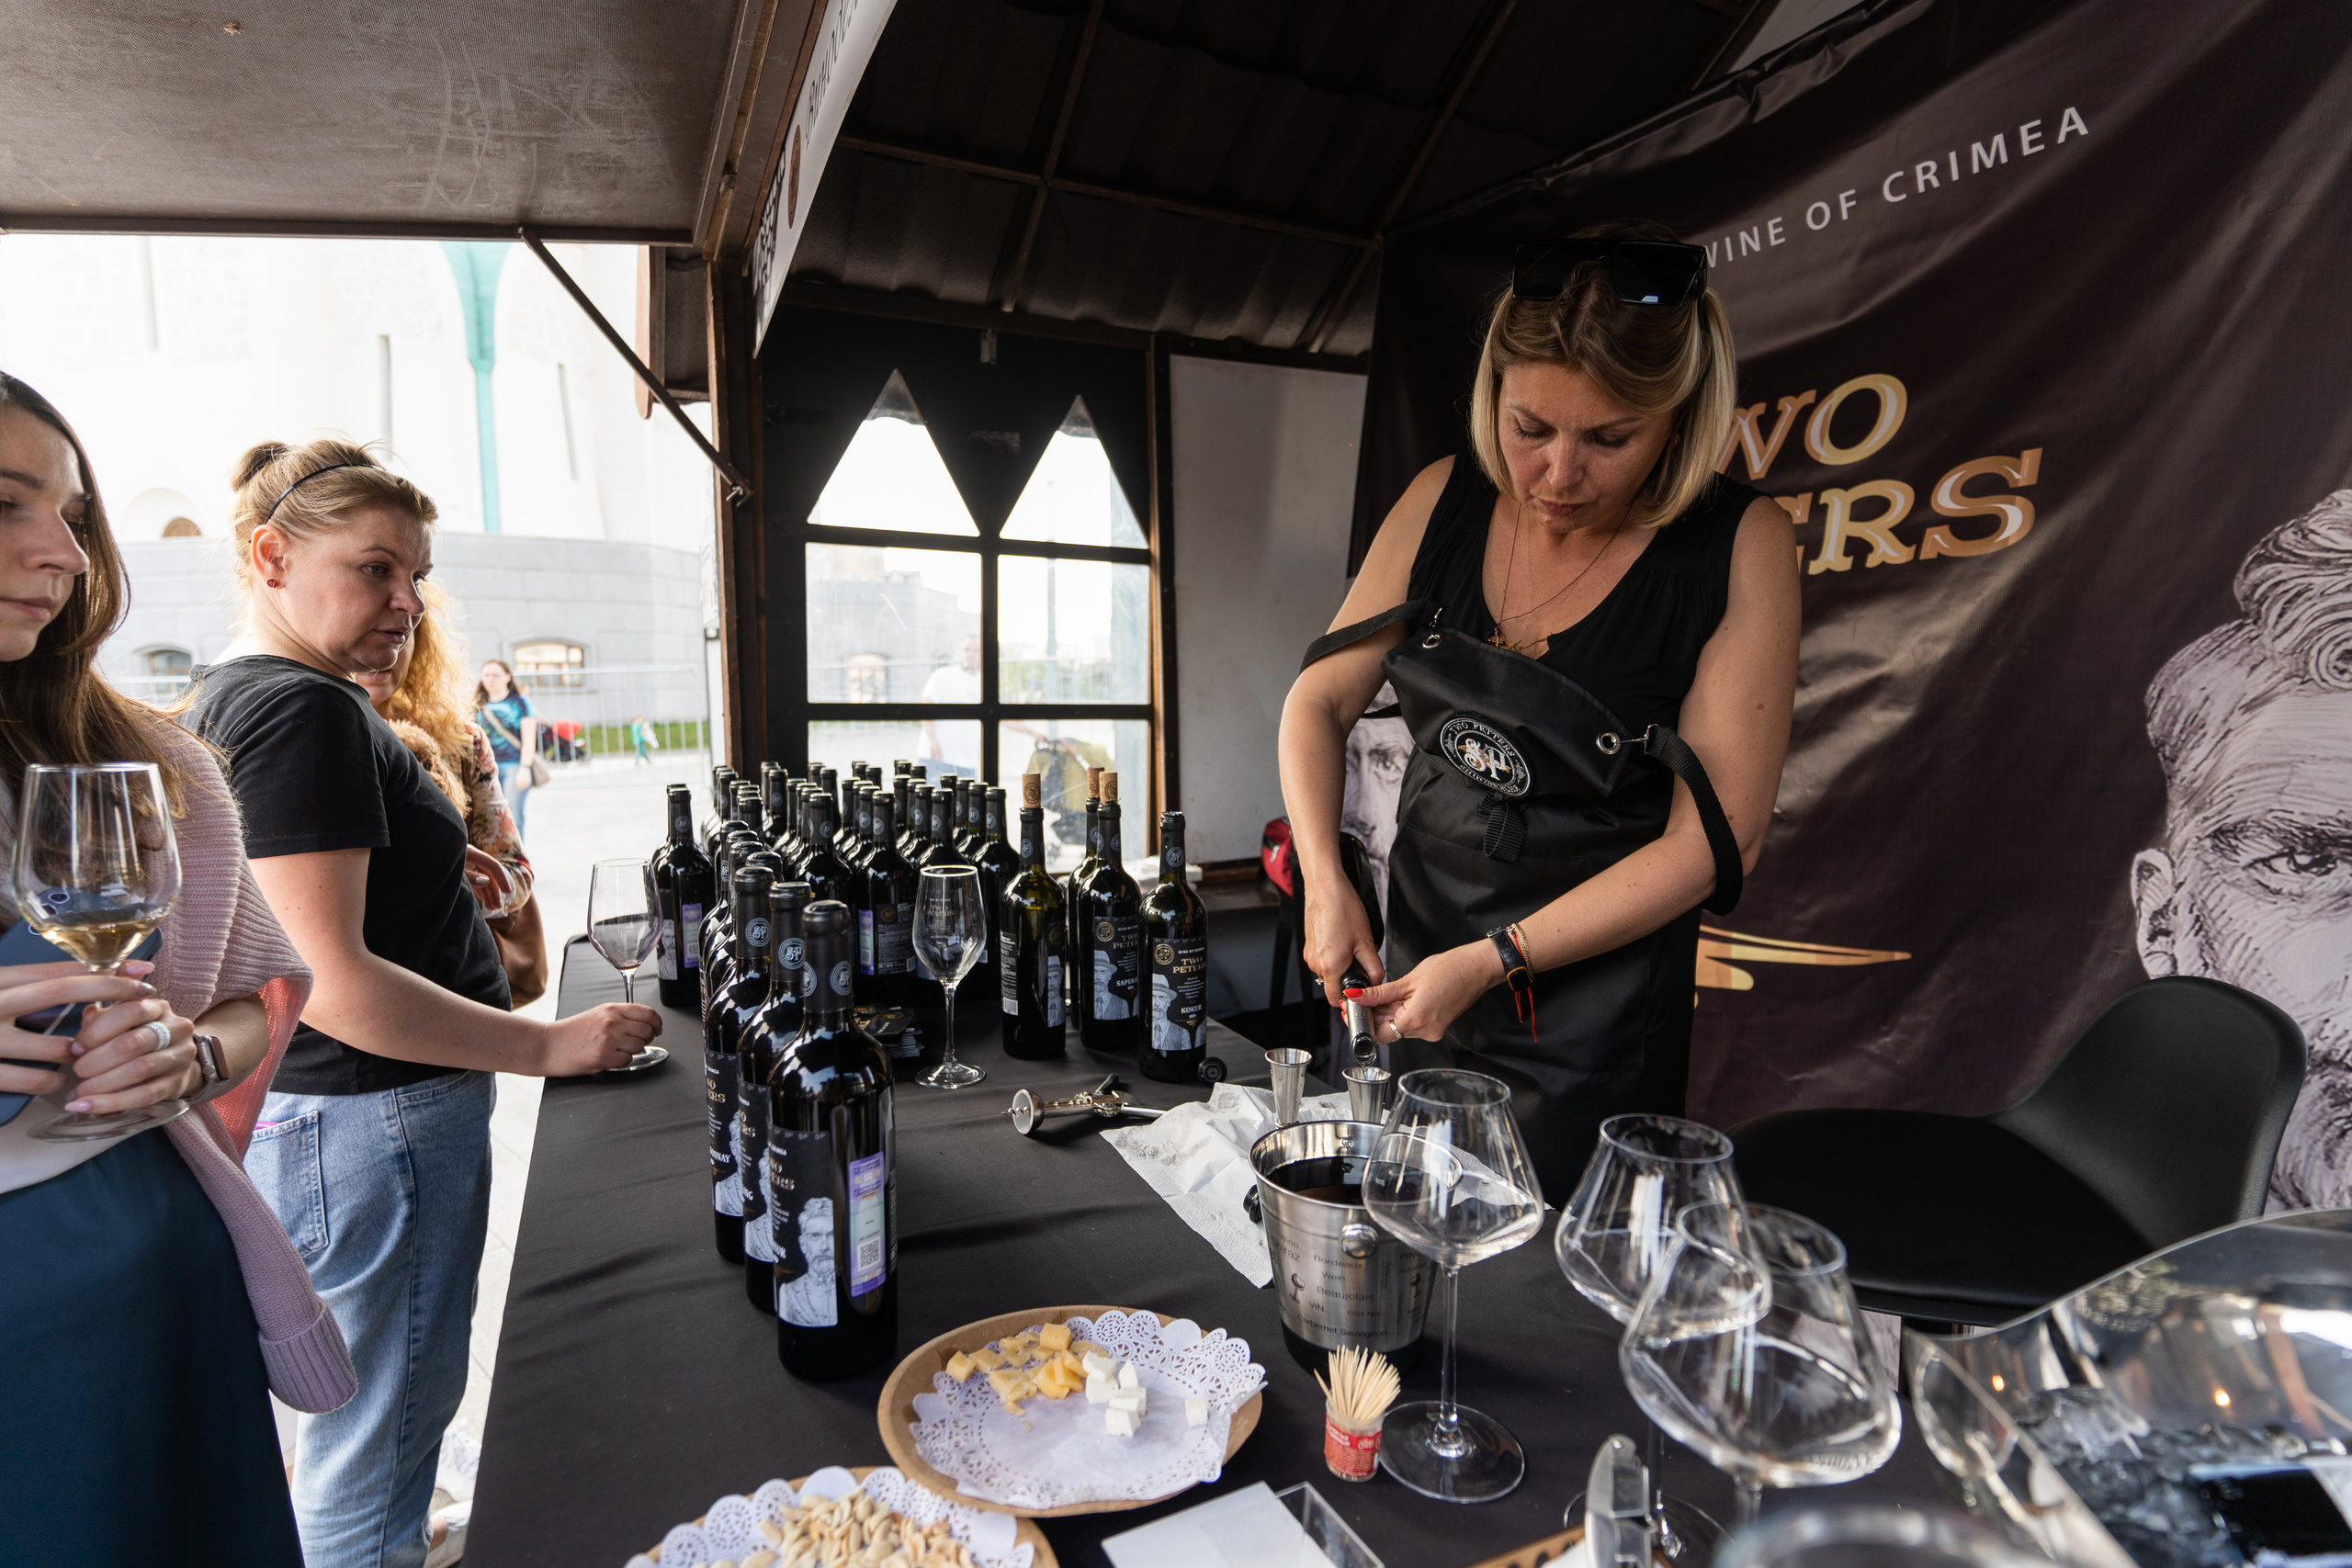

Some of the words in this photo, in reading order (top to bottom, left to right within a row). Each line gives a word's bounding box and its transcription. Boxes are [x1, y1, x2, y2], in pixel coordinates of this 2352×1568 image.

[1705, 217, 1786, 268] WINE
[1805, 189, 1858, 231] OF
[1883, 106, 2089, 204] CRIMEA
[1714, 373, 1908, 481] WO
[1181, 956, 1203, 966] TWO
[1172, 962, 1207, 974] PETERS
[1181, 1004, 1203, 1014] KOKUR
[1314, 1255, 1363, 1269] Bordeaux
[1321, 1271, 1346, 1282] Wein
[1317, 1285, 1374, 1302] Beaujolais
